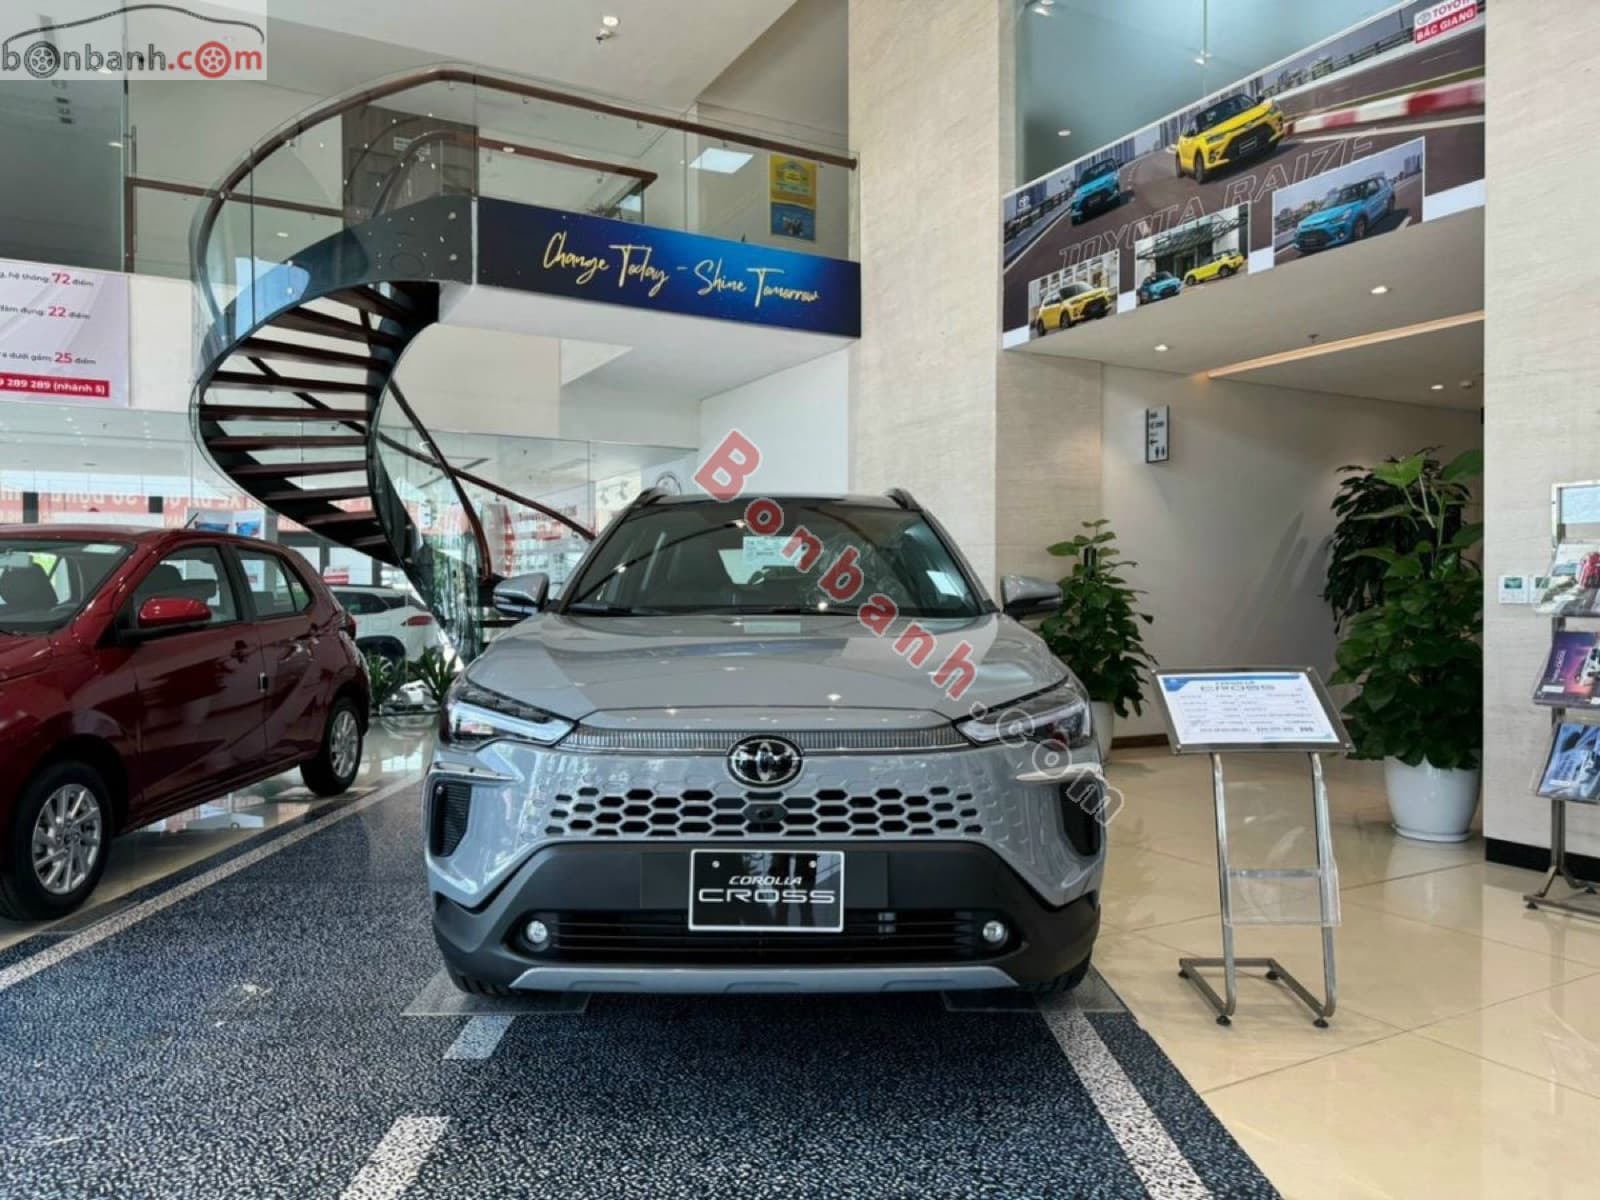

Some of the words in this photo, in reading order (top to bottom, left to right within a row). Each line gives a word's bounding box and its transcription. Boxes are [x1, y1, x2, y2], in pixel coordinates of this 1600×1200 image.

[1432, 0, 1471, 17] TOYO
[1440, 7, 1474, 30] GIANG
[542, 231, 609, 285] Change
[608, 244, 669, 297] Today
[693, 257, 747, 296] Shine
[51, 272, 71, 286] 72
[48, 305, 66, 318] 22
[54, 351, 73, 364] 25
[7, 379, 28, 388] 289
[30, 380, 51, 390] 289
[728, 875, 802, 886] COROLLA
[698, 888, 835, 904] CROSS
